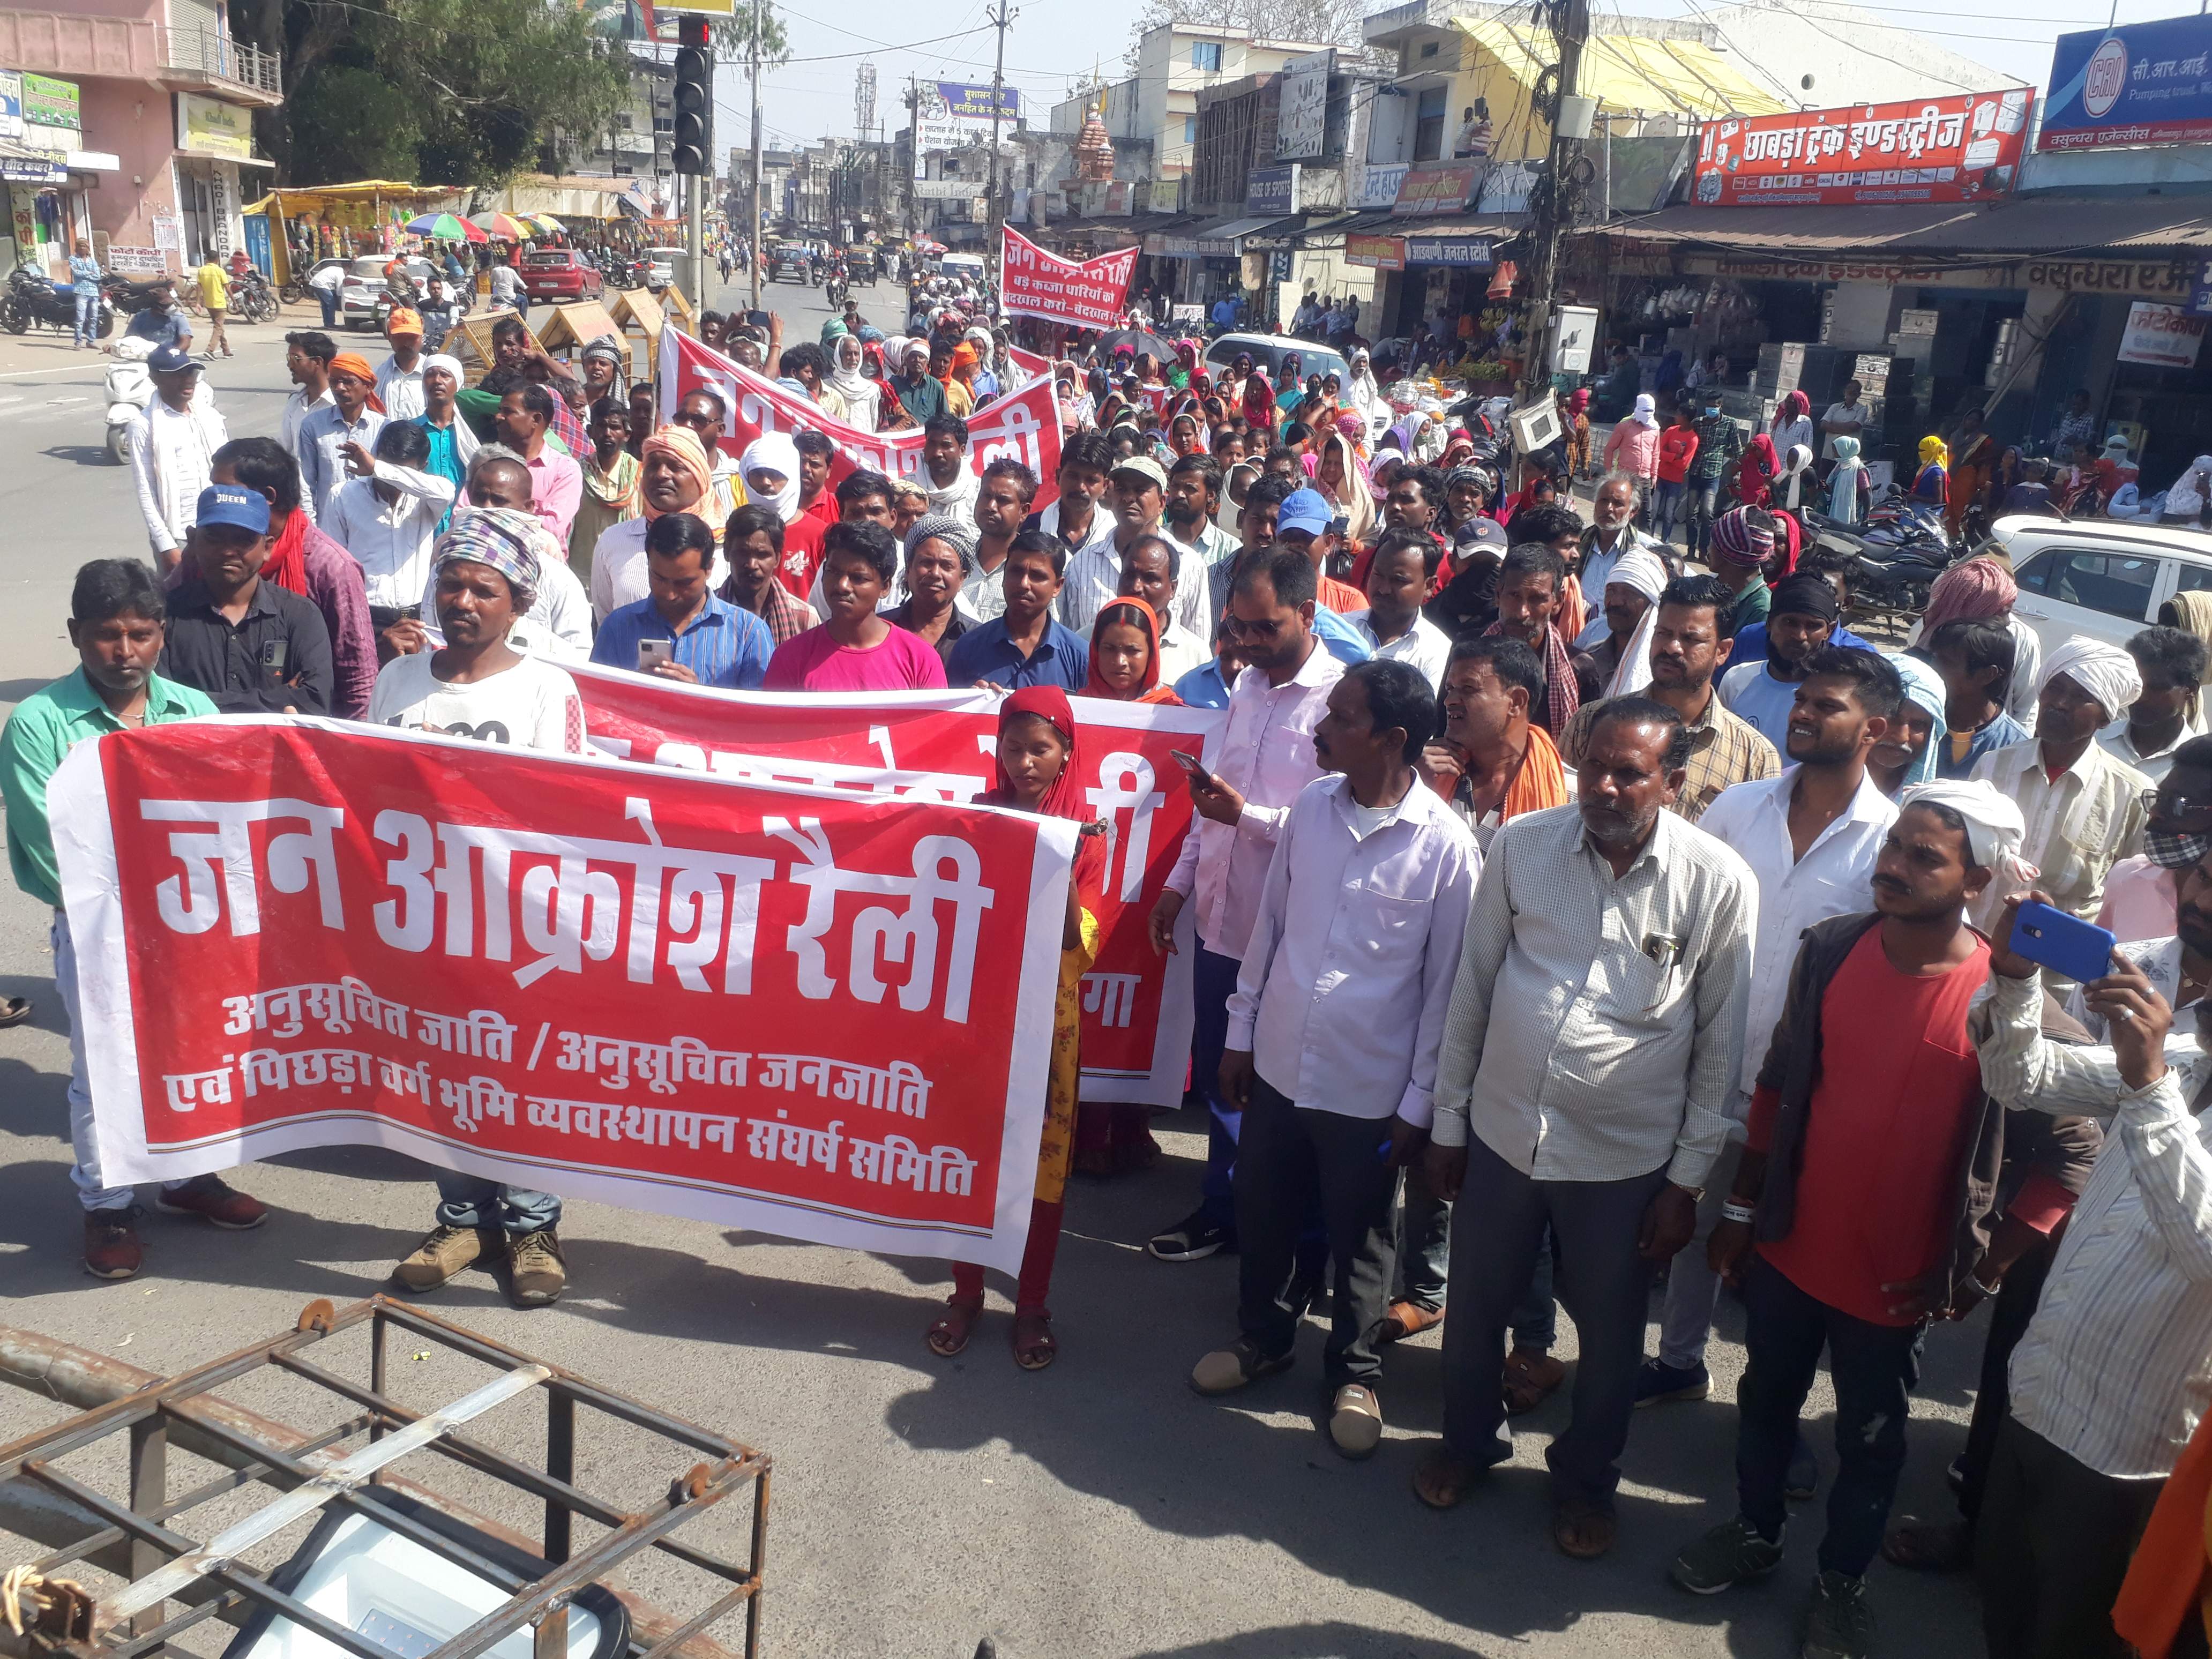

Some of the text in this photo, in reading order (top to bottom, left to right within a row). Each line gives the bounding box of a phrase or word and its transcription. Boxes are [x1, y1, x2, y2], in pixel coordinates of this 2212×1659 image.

[2132, 51, 2209, 80] सी.आर.आई.
[2089, 56, 2122, 99] CRI
[965, 89, 990, 101] सुशासन
[2129, 88, 2170, 101] Pumping
[953, 103, 976, 115] जनहित
[978, 103, 985, 114] के
[925, 125, 945, 134] सप्ताह
[981, 128, 995, 137] दिव
[1743, 104, 1969, 168] छाबड़ा ट्रंक इण्डस्ट्रीज
[2051, 133, 2093, 147] वसुन्धरा
[2097, 125, 2150, 144] एजेन्सीस
[1250, 180, 1290, 198] HOUSE OF SPORTS
[217, 208, 230, 258] BHANDAR
[1412, 241, 1442, 261] आडवाणी
[1443, 245, 1469, 261] जनरल
[1470, 240, 1490, 261] स्टोर्स
[1004, 289, 1042, 307] बेदखल
[1032, 279, 1064, 294] कब्जा
[1066, 283, 1102, 301] धारियों
[1102, 290, 1115, 304] को
[216, 493, 246, 505] QUEEN
[139, 798, 346, 939] जन
[373, 796, 776, 997] आक्रोश
[763, 815, 996, 1025] रैली
[222, 975, 407, 1056] अनुसूचित
[416, 1008, 518, 1064] जाति
[554, 1030, 749, 1096] अनुसूचित
[758, 1052, 935, 1121] जनजाति
[162, 1046, 981, 1197] एवं पिछड़ा वर्ग भूमि व्यवस्थापन संघर्ष समिति
